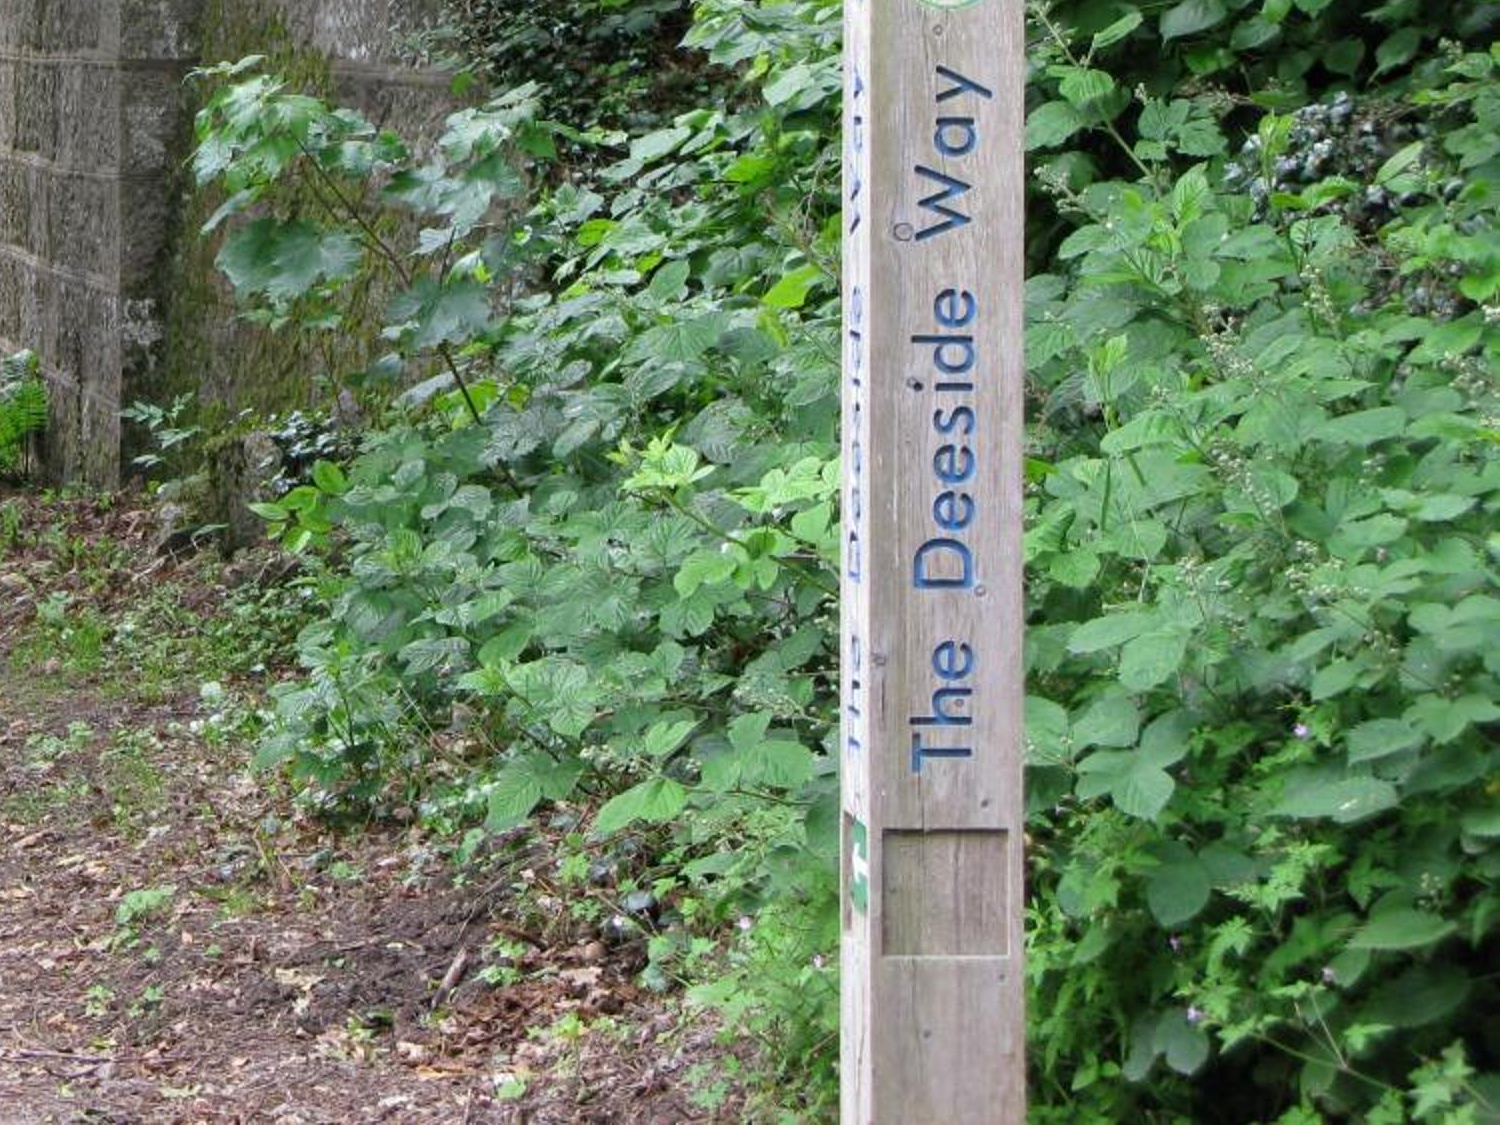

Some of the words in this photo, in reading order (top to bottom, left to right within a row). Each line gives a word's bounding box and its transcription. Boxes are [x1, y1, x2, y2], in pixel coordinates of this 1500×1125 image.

[914, 64, 993, 241] Way
[909, 287, 975, 589] Deeside
[909, 640, 975, 773] The
